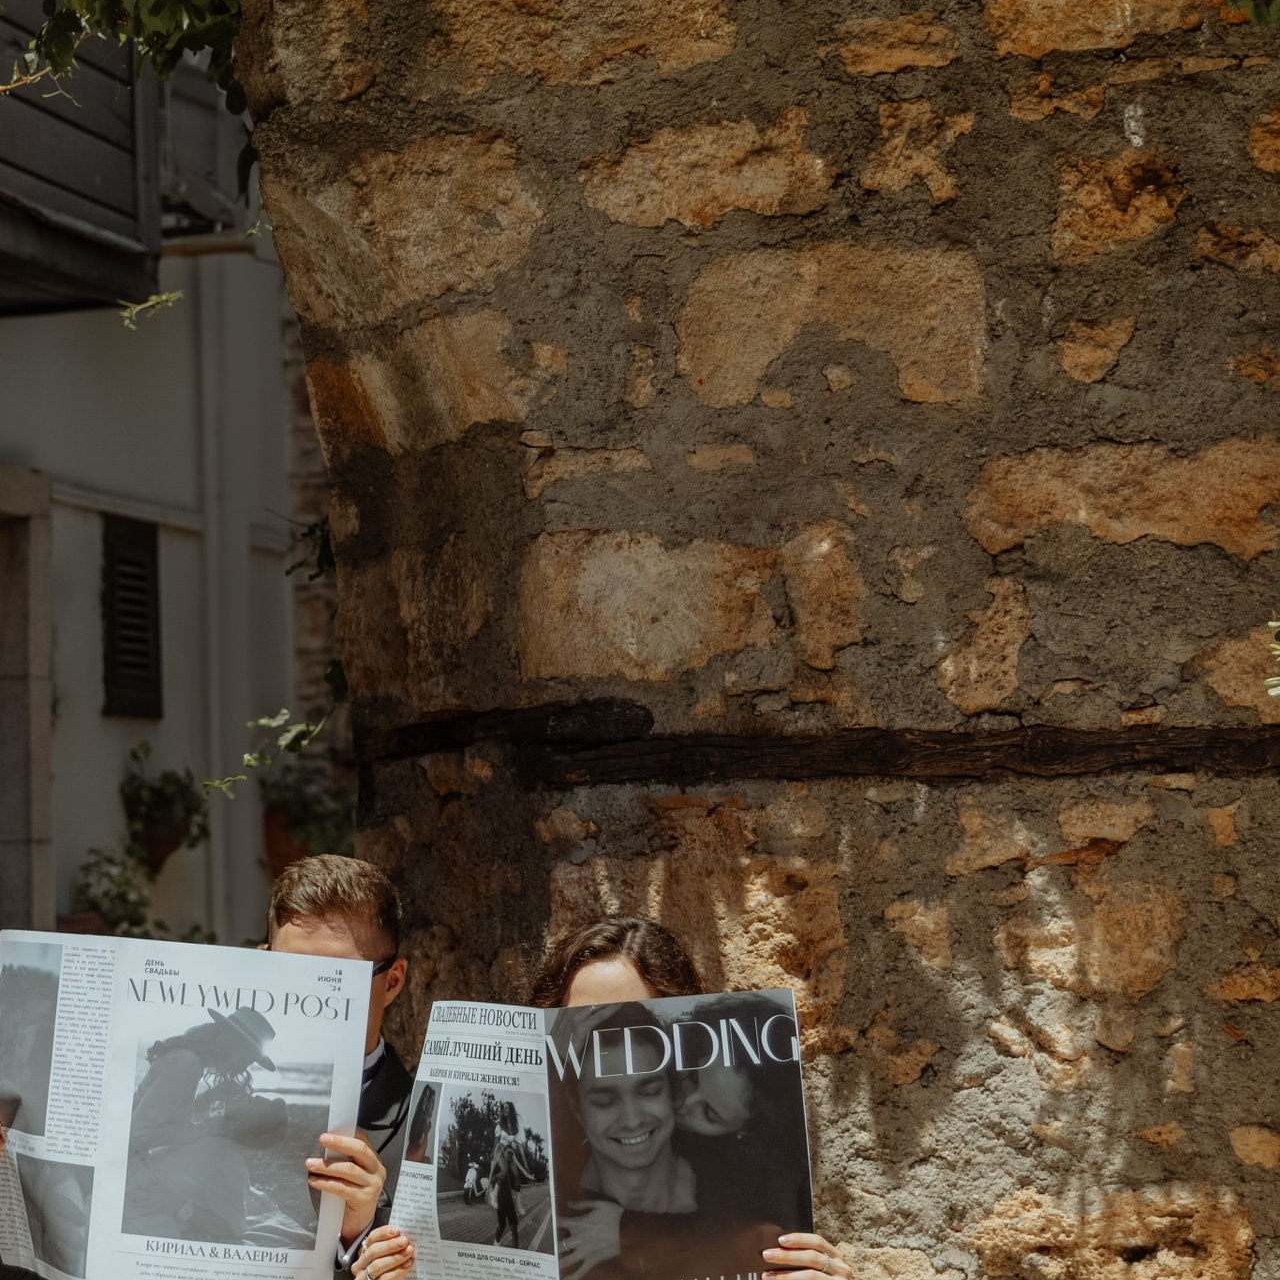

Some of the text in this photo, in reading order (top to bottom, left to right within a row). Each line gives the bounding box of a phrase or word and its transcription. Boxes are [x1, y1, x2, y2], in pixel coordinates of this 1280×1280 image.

[144, 959, 165, 967] ДЕНЬ
[144, 967, 180, 976] СВАДЬБЫ
[317, 975, 342, 984] ИЮНЯ
[127, 978, 356, 1021] NEWLYWED POST
[432, 1005, 537, 1030] СВАДЕБНЫЕ НОВОСТИ
[423, 1036, 544, 1067] САМЫЙ ЛУЧШИЙ ДЕНЬ
[545, 1014, 799, 1082] WEDDING
[453, 1069, 479, 1082] КИРИЛЛ
[480, 1073, 520, 1087] ЖЕНЯТСЯ!
[145, 1239, 289, 1264] КИРИЛЛ & ВАЛЕРИЯ
[489, 1256, 516, 1264] СЧАСТЬЯ
[519, 1259, 541, 1269] СЕЙЧАС
